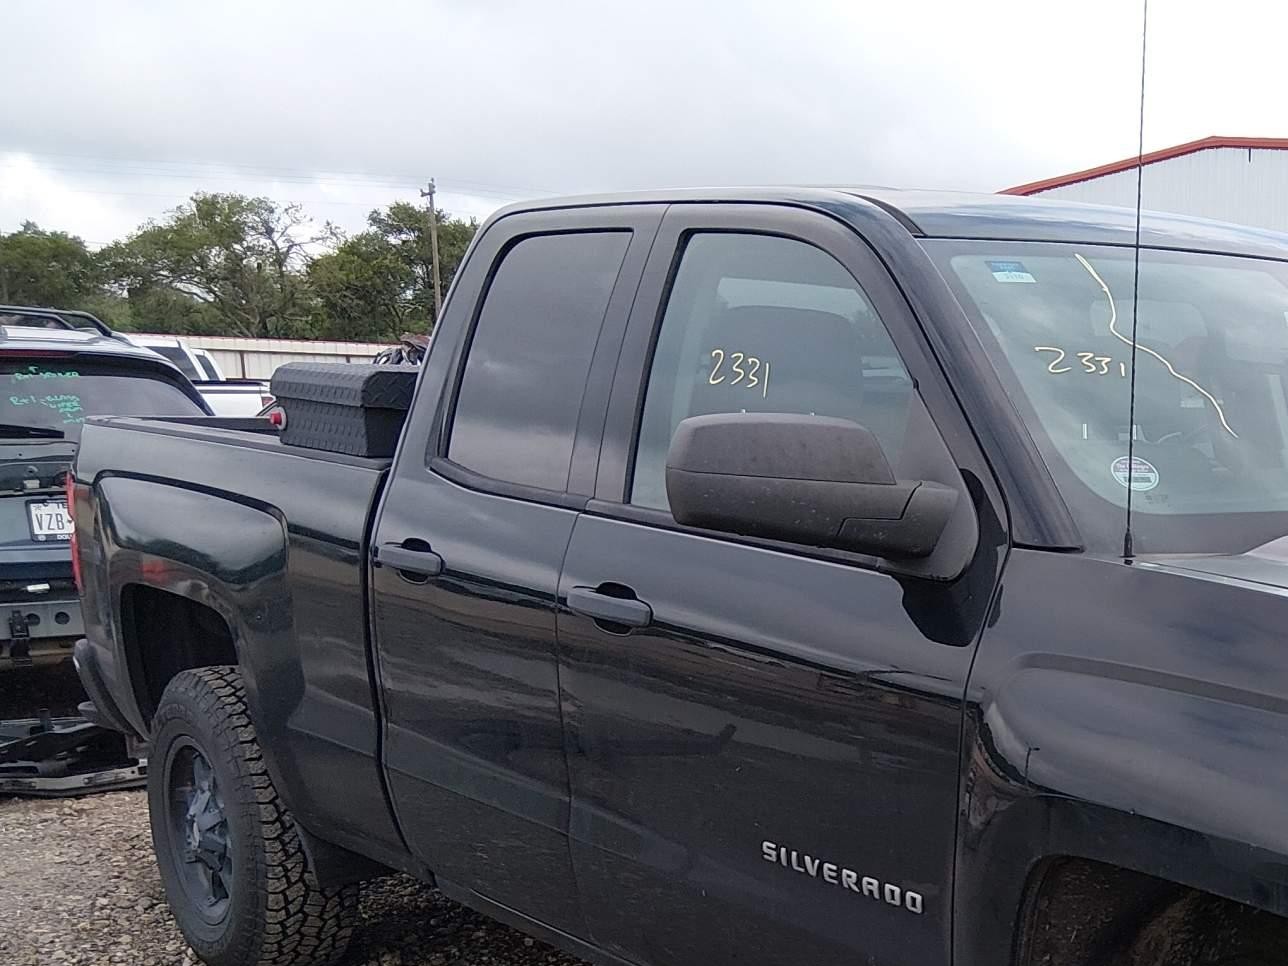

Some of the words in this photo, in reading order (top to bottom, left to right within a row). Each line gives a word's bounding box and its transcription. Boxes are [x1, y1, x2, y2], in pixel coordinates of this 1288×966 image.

[709, 349, 769, 398] 2331
[1034, 346, 1125, 377] 2331
[762, 841, 924, 914] SILVERADO
